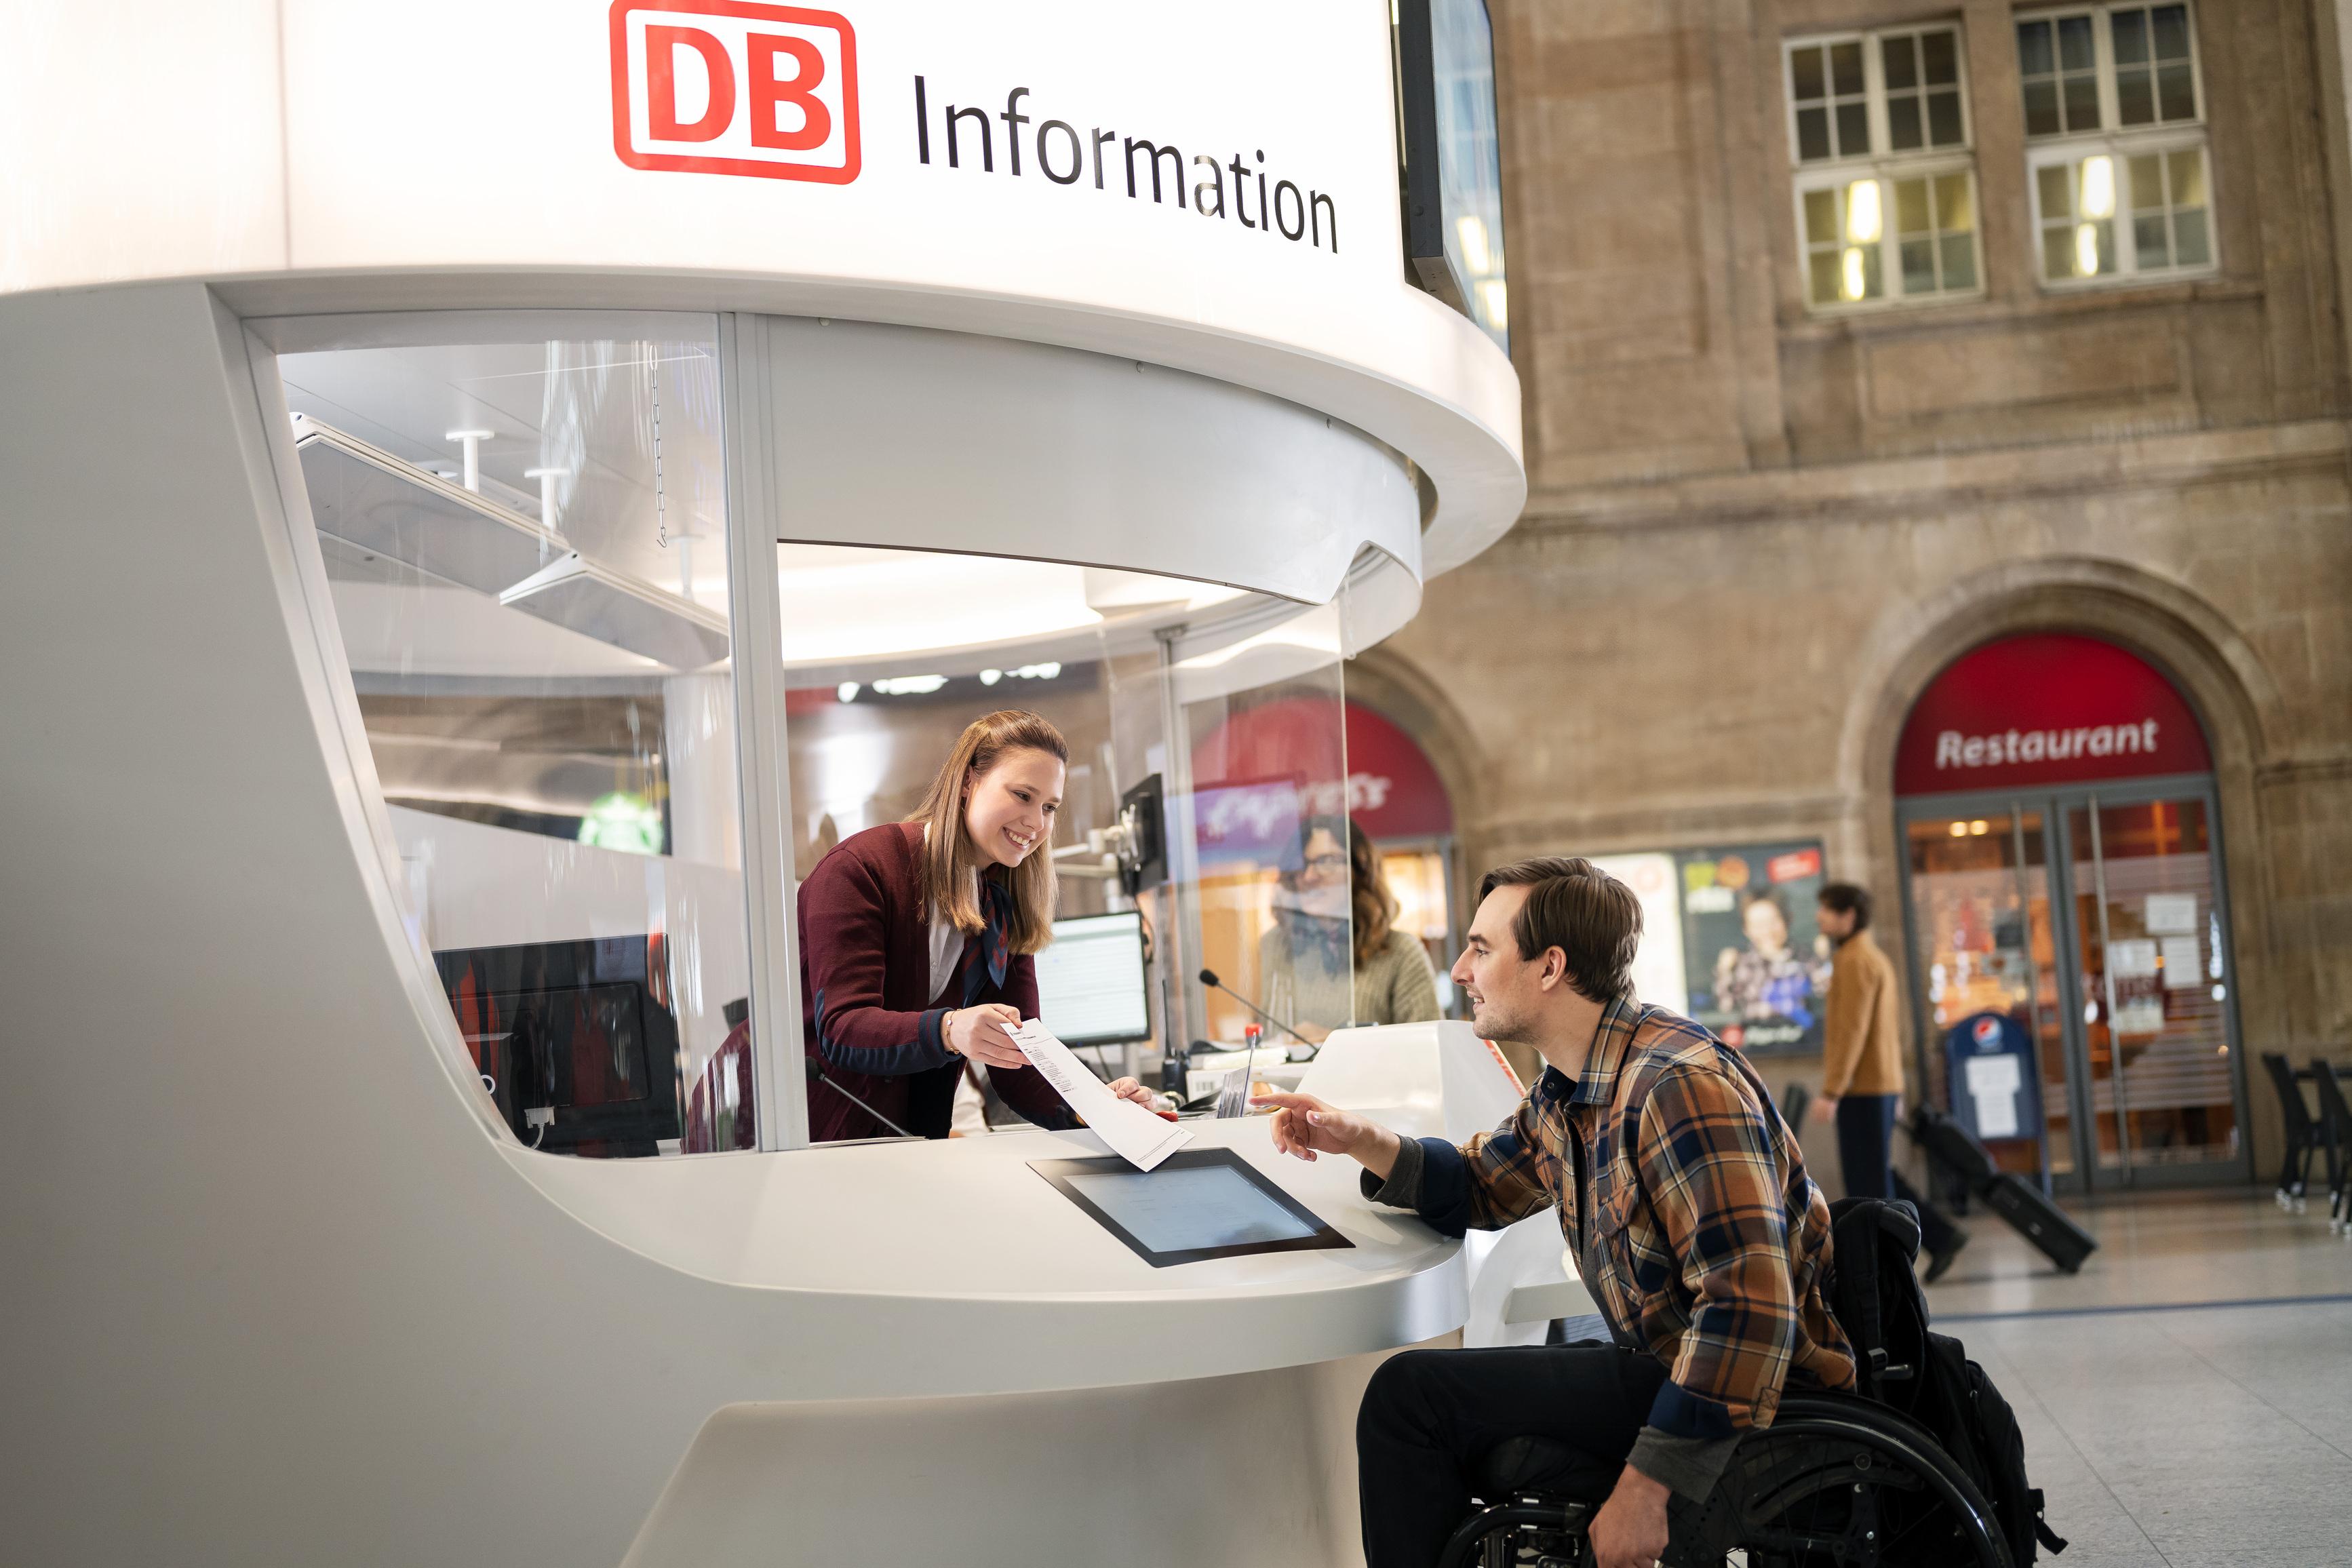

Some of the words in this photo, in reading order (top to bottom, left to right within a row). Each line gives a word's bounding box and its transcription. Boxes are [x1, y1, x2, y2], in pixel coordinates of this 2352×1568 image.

[645, 24, 831, 151] DB
[914, 75, 1338, 254] Information
[1935, 718, 2159, 770] Restaurant
